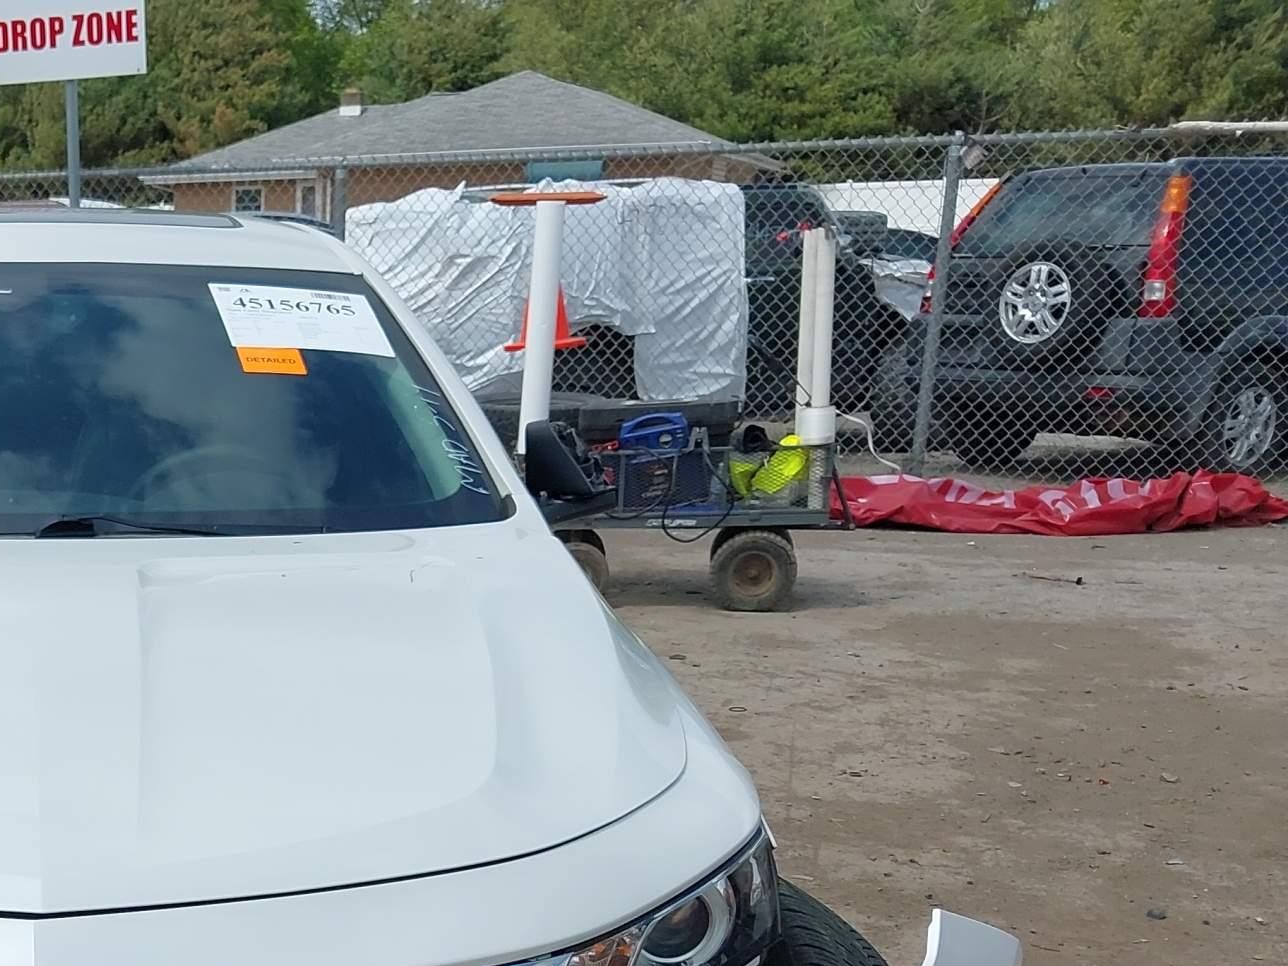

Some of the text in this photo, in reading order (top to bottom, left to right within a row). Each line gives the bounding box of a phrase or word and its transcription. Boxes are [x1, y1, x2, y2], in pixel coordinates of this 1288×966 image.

[71, 9, 139, 47] ZONE
[232, 296, 357, 317] 45156765
[245, 355, 297, 366] DETAILED
